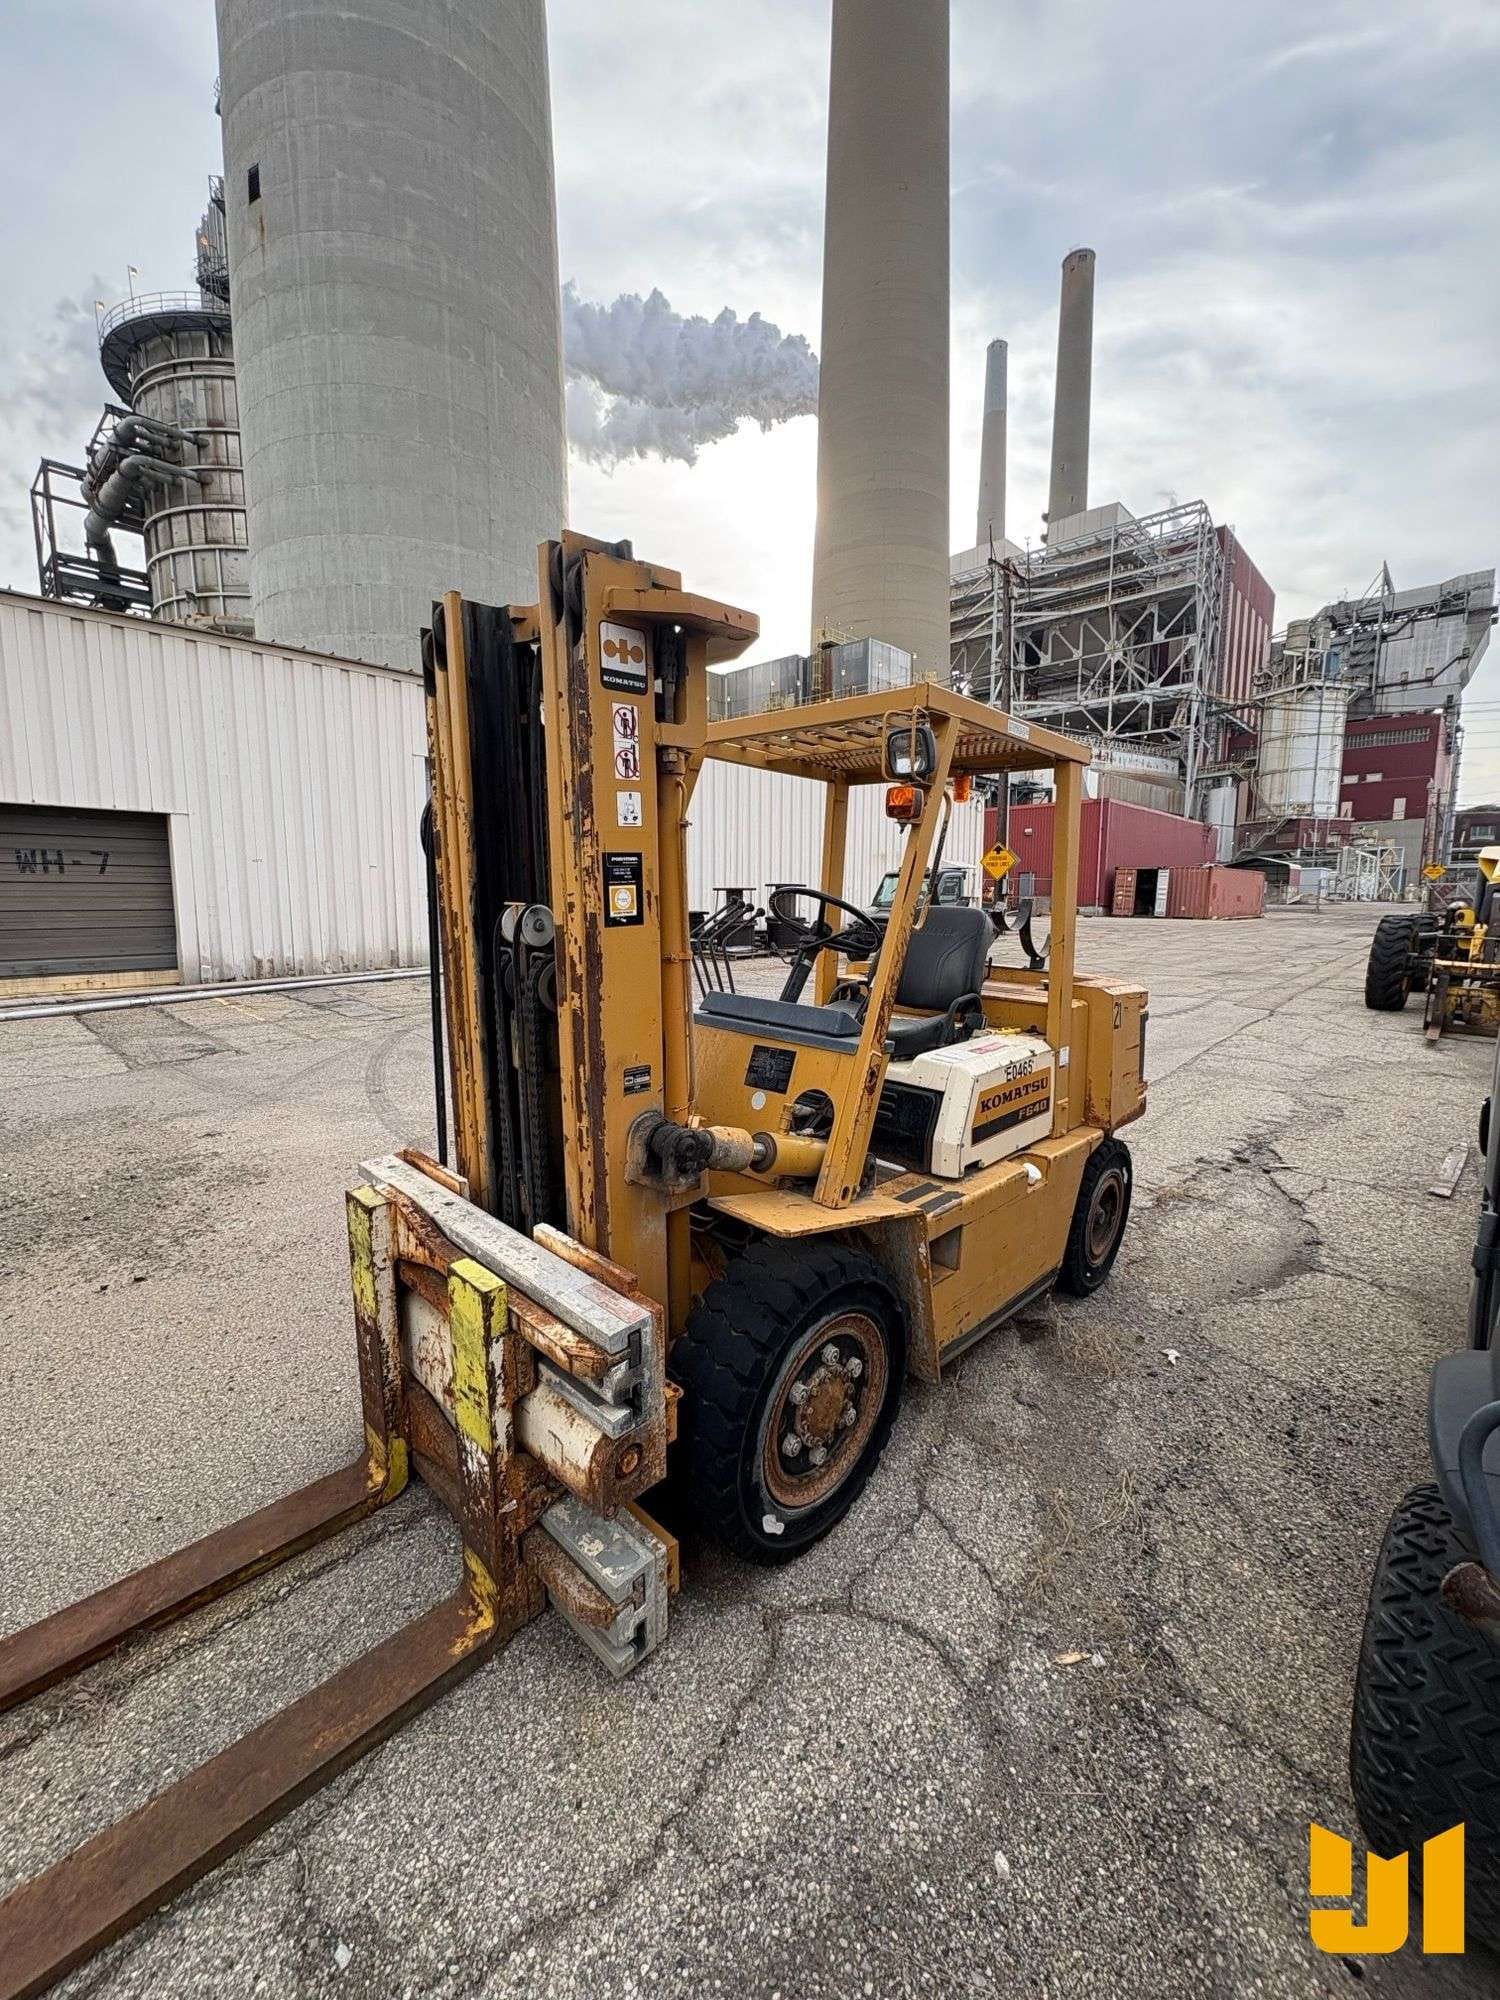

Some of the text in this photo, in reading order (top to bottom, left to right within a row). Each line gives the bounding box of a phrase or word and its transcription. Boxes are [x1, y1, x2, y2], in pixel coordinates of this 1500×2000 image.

[602, 675, 646, 688] KOMATSU
[1005, 1059, 1034, 1082] E0465
[980, 1077, 1049, 1113] KOMATSU
